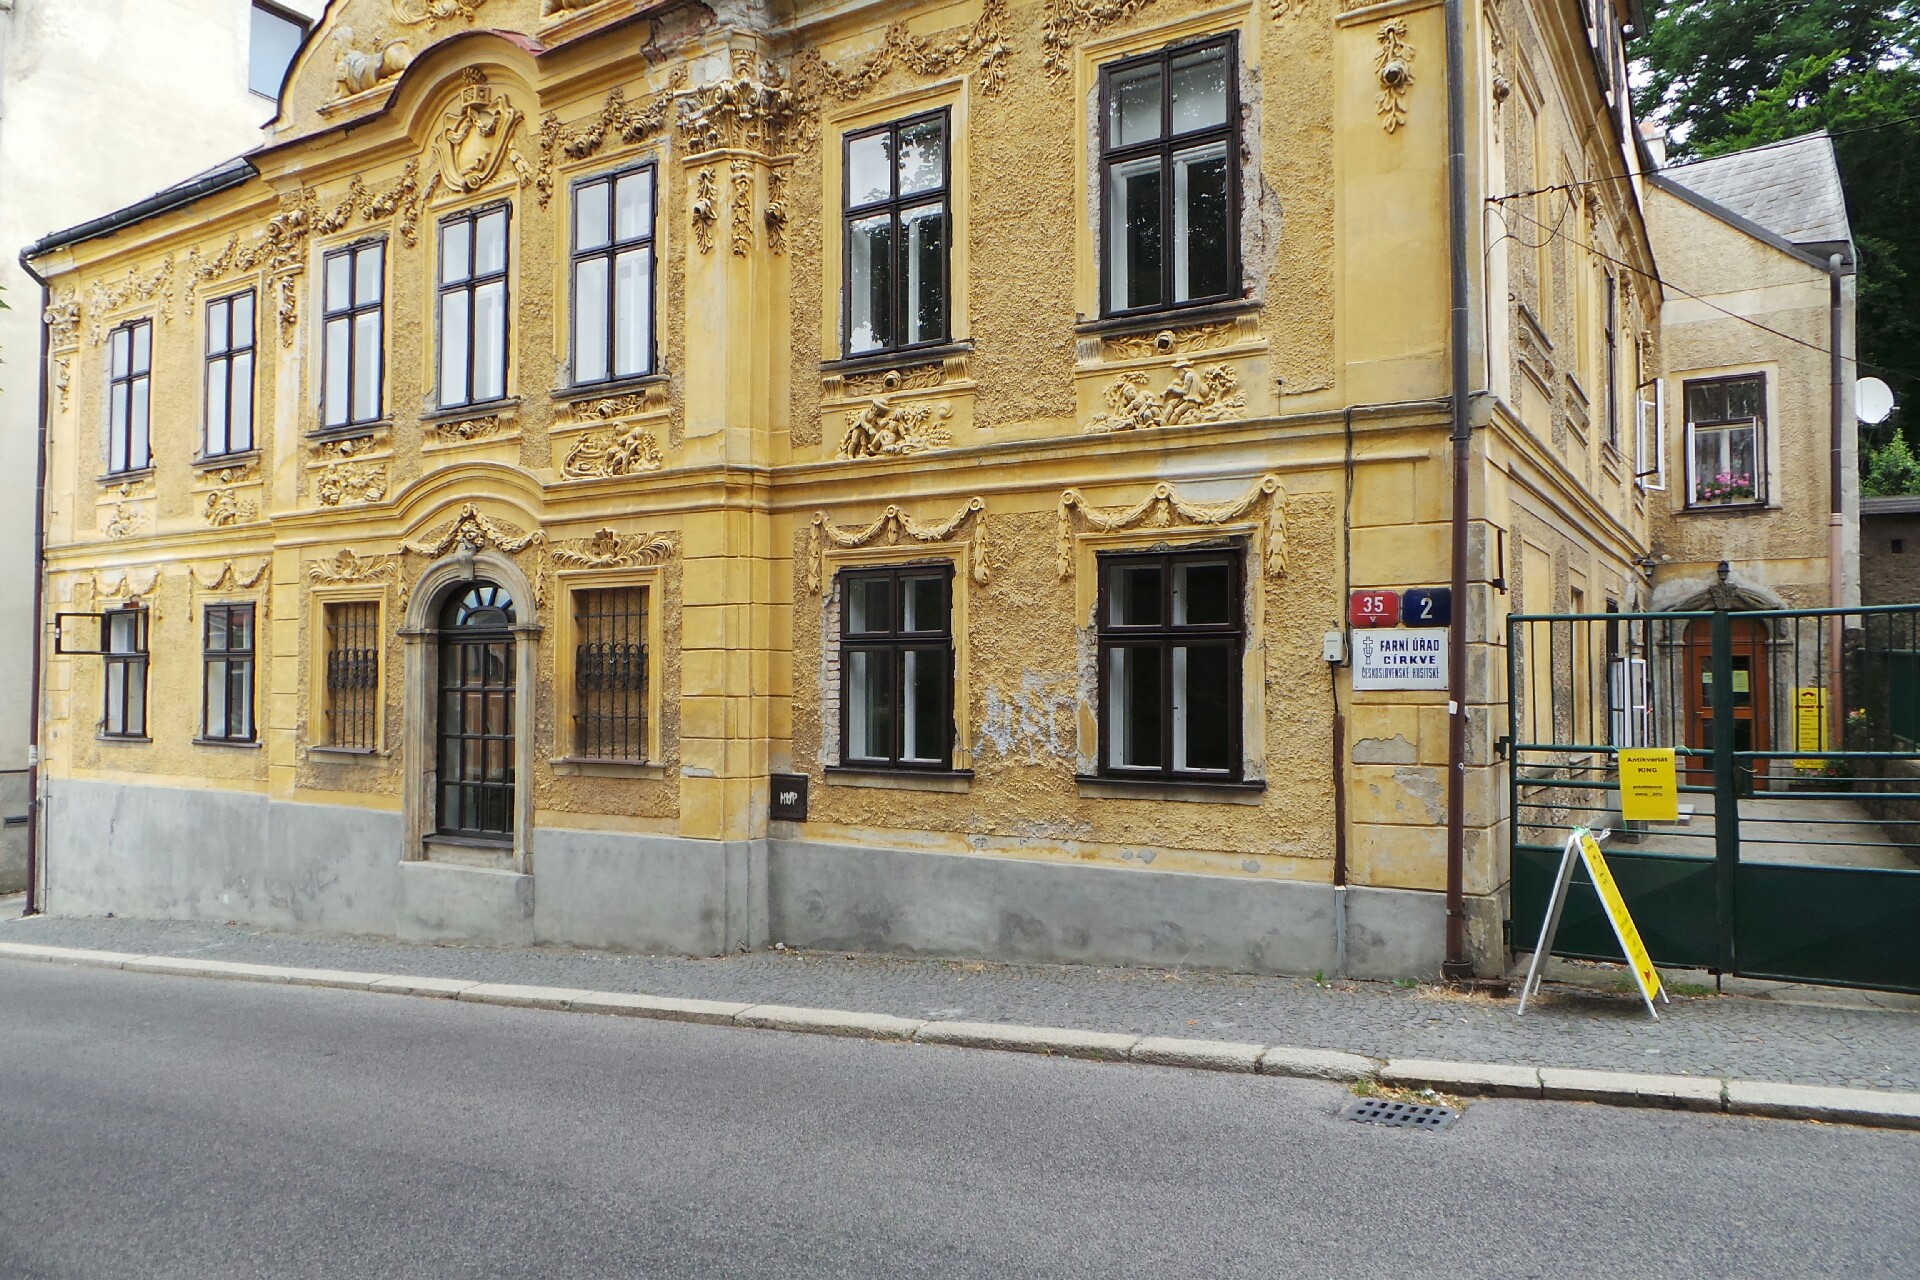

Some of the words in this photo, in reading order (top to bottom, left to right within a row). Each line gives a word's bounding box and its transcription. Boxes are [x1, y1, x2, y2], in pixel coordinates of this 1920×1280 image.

[1363, 596, 1384, 613] 35
[1420, 597, 1433, 619] 2
[1380, 638, 1408, 652] FARNÍ
[1412, 638, 1440, 651] ÚŘAD
[1383, 654, 1436, 665] CÍRKVE
[1361, 667, 1409, 679] ČESKOSLOVENSKÉ
